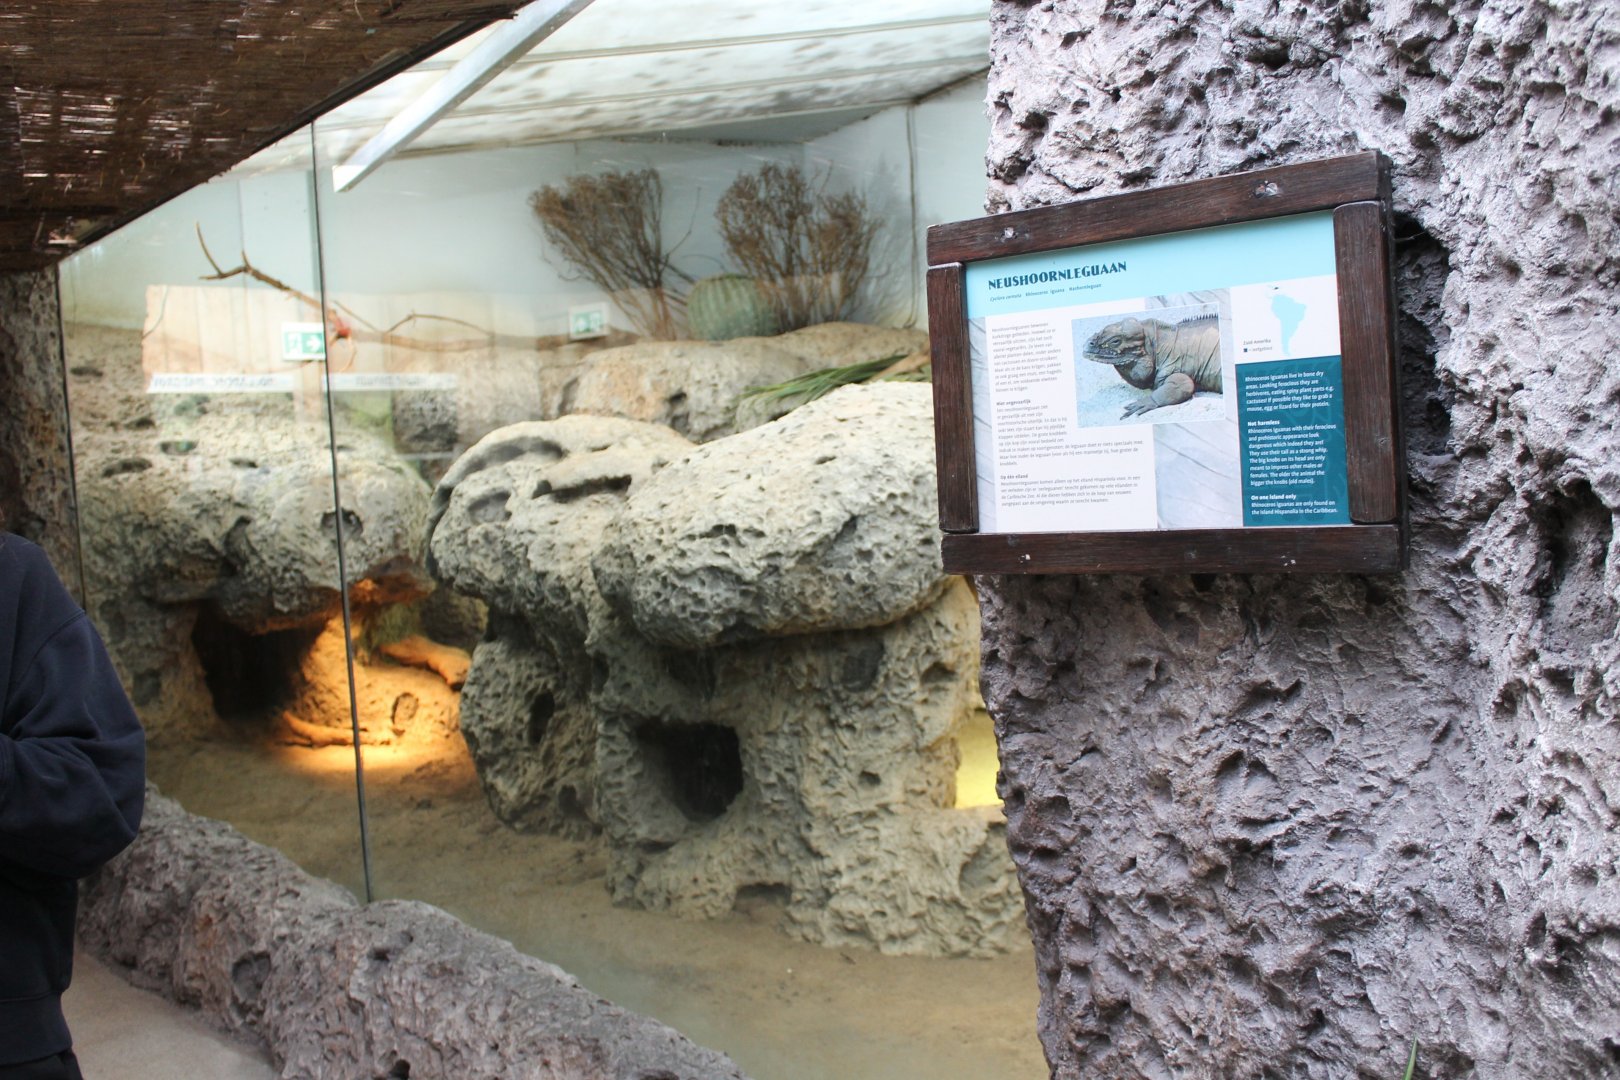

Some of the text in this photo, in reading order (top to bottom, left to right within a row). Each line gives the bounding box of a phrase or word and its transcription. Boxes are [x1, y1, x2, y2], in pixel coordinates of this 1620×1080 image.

[987, 260, 1127, 290] NEUSHOORNLEGUAAN
[1269, 372, 1288, 380] iguanas
[1315, 369, 1324, 377] dry
[1258, 381, 1277, 389] Looking
[1299, 378, 1310, 386] they
[1271, 395, 1291, 403] possible
[1317, 392, 1329, 400] grab
[1311, 400, 1331, 408] protein.
[1272, 425, 1291, 433] iguanas
[1257, 433, 1282, 441] prehistoric
[1248, 441, 1272, 449] dangerous
